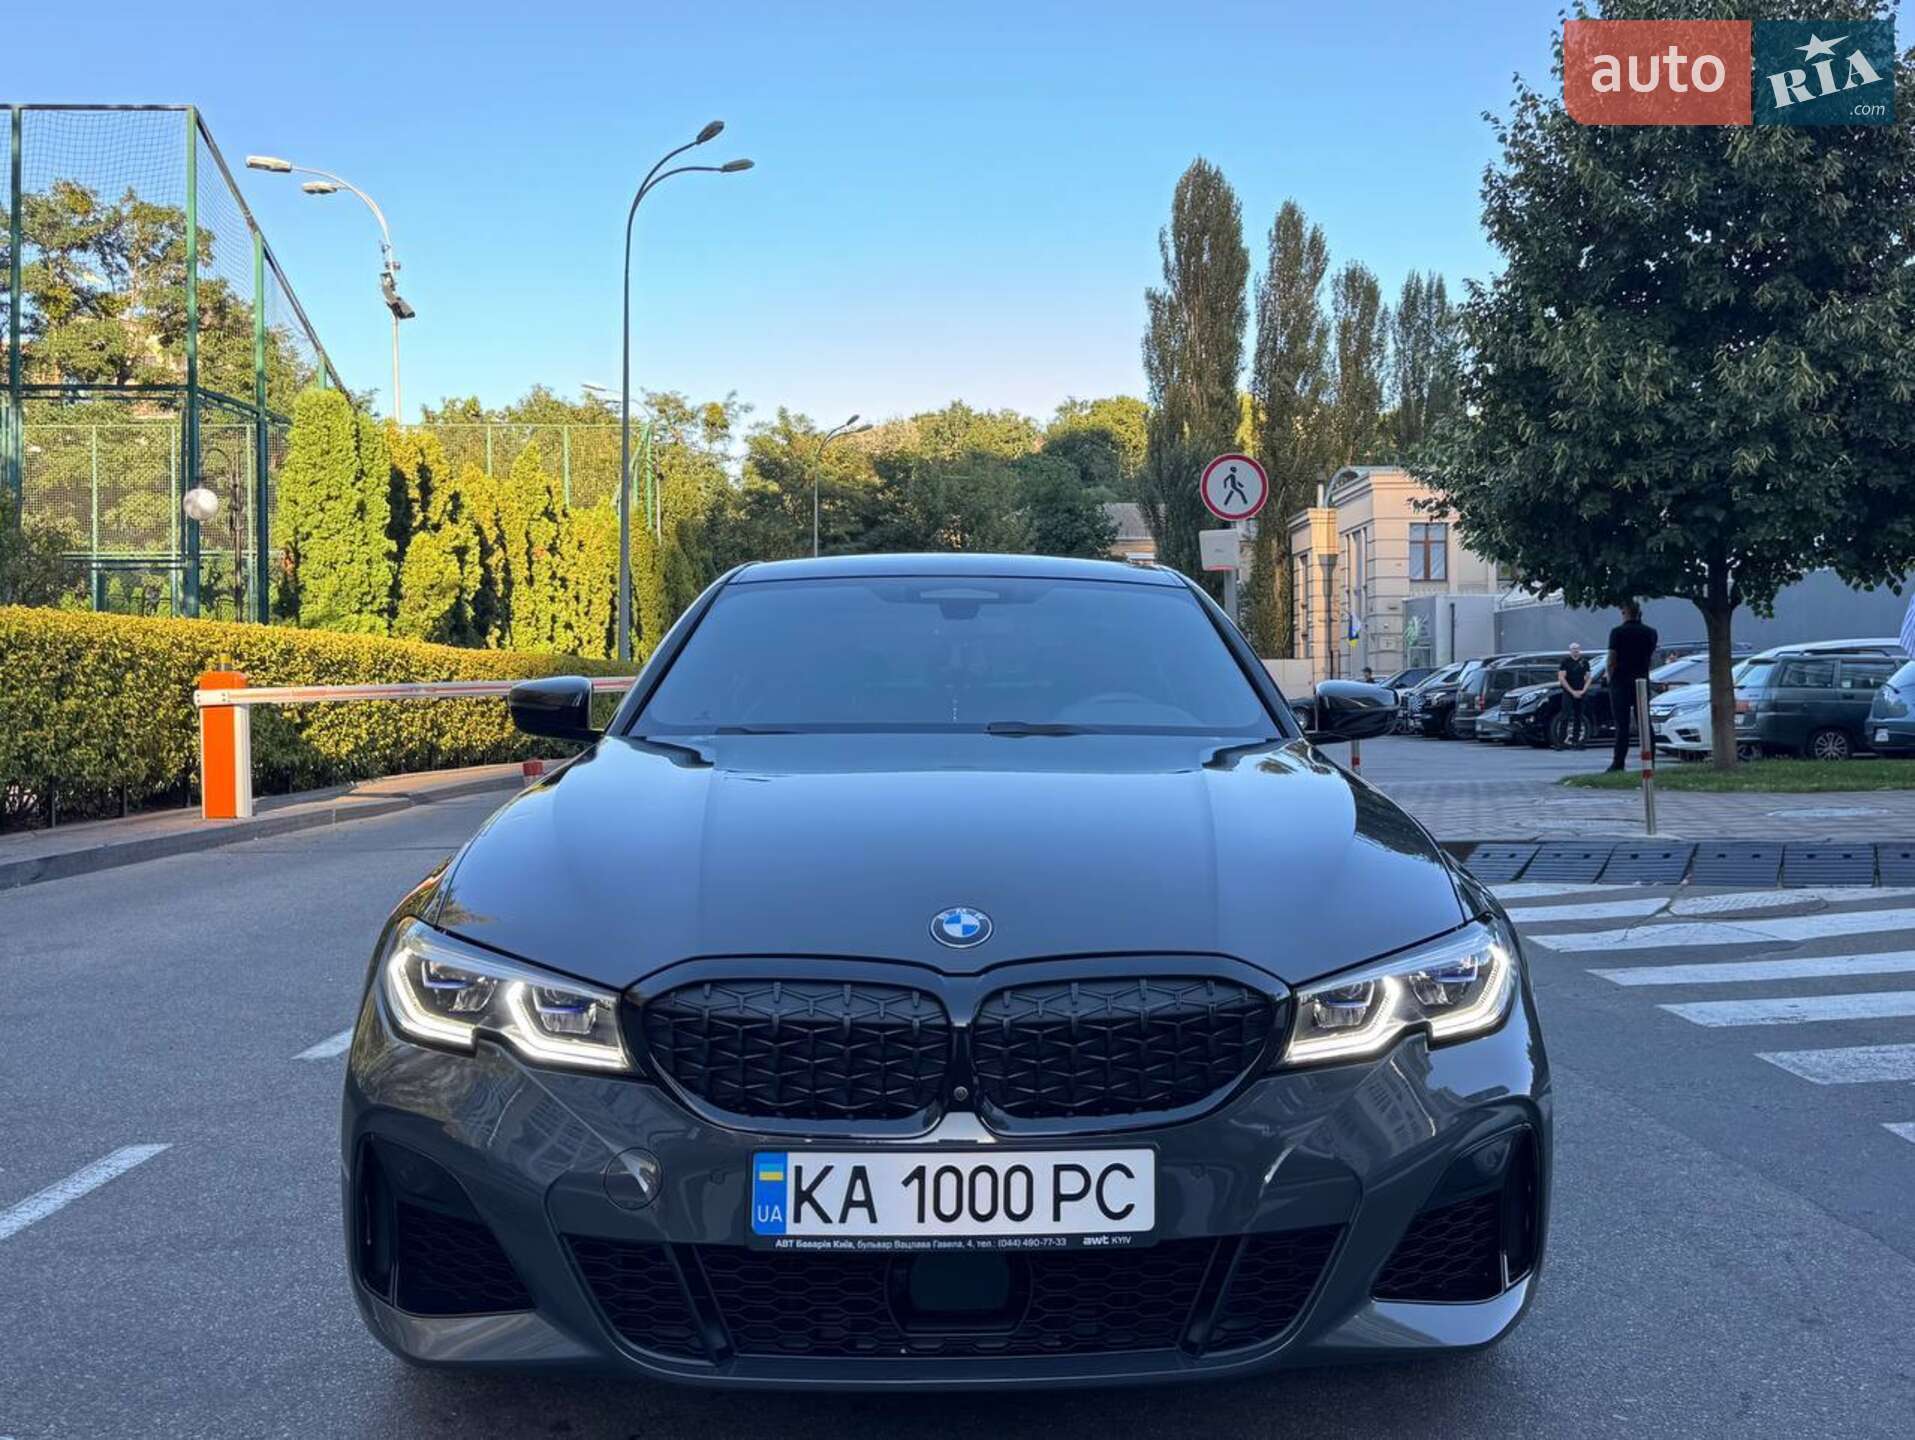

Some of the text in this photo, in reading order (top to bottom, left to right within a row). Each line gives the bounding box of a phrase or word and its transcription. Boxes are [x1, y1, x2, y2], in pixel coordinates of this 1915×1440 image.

[793, 1163, 1135, 1223] KA 1000 PC
[757, 1205, 782, 1222] UA
[1083, 1235, 1132, 1245] awt KYIV
